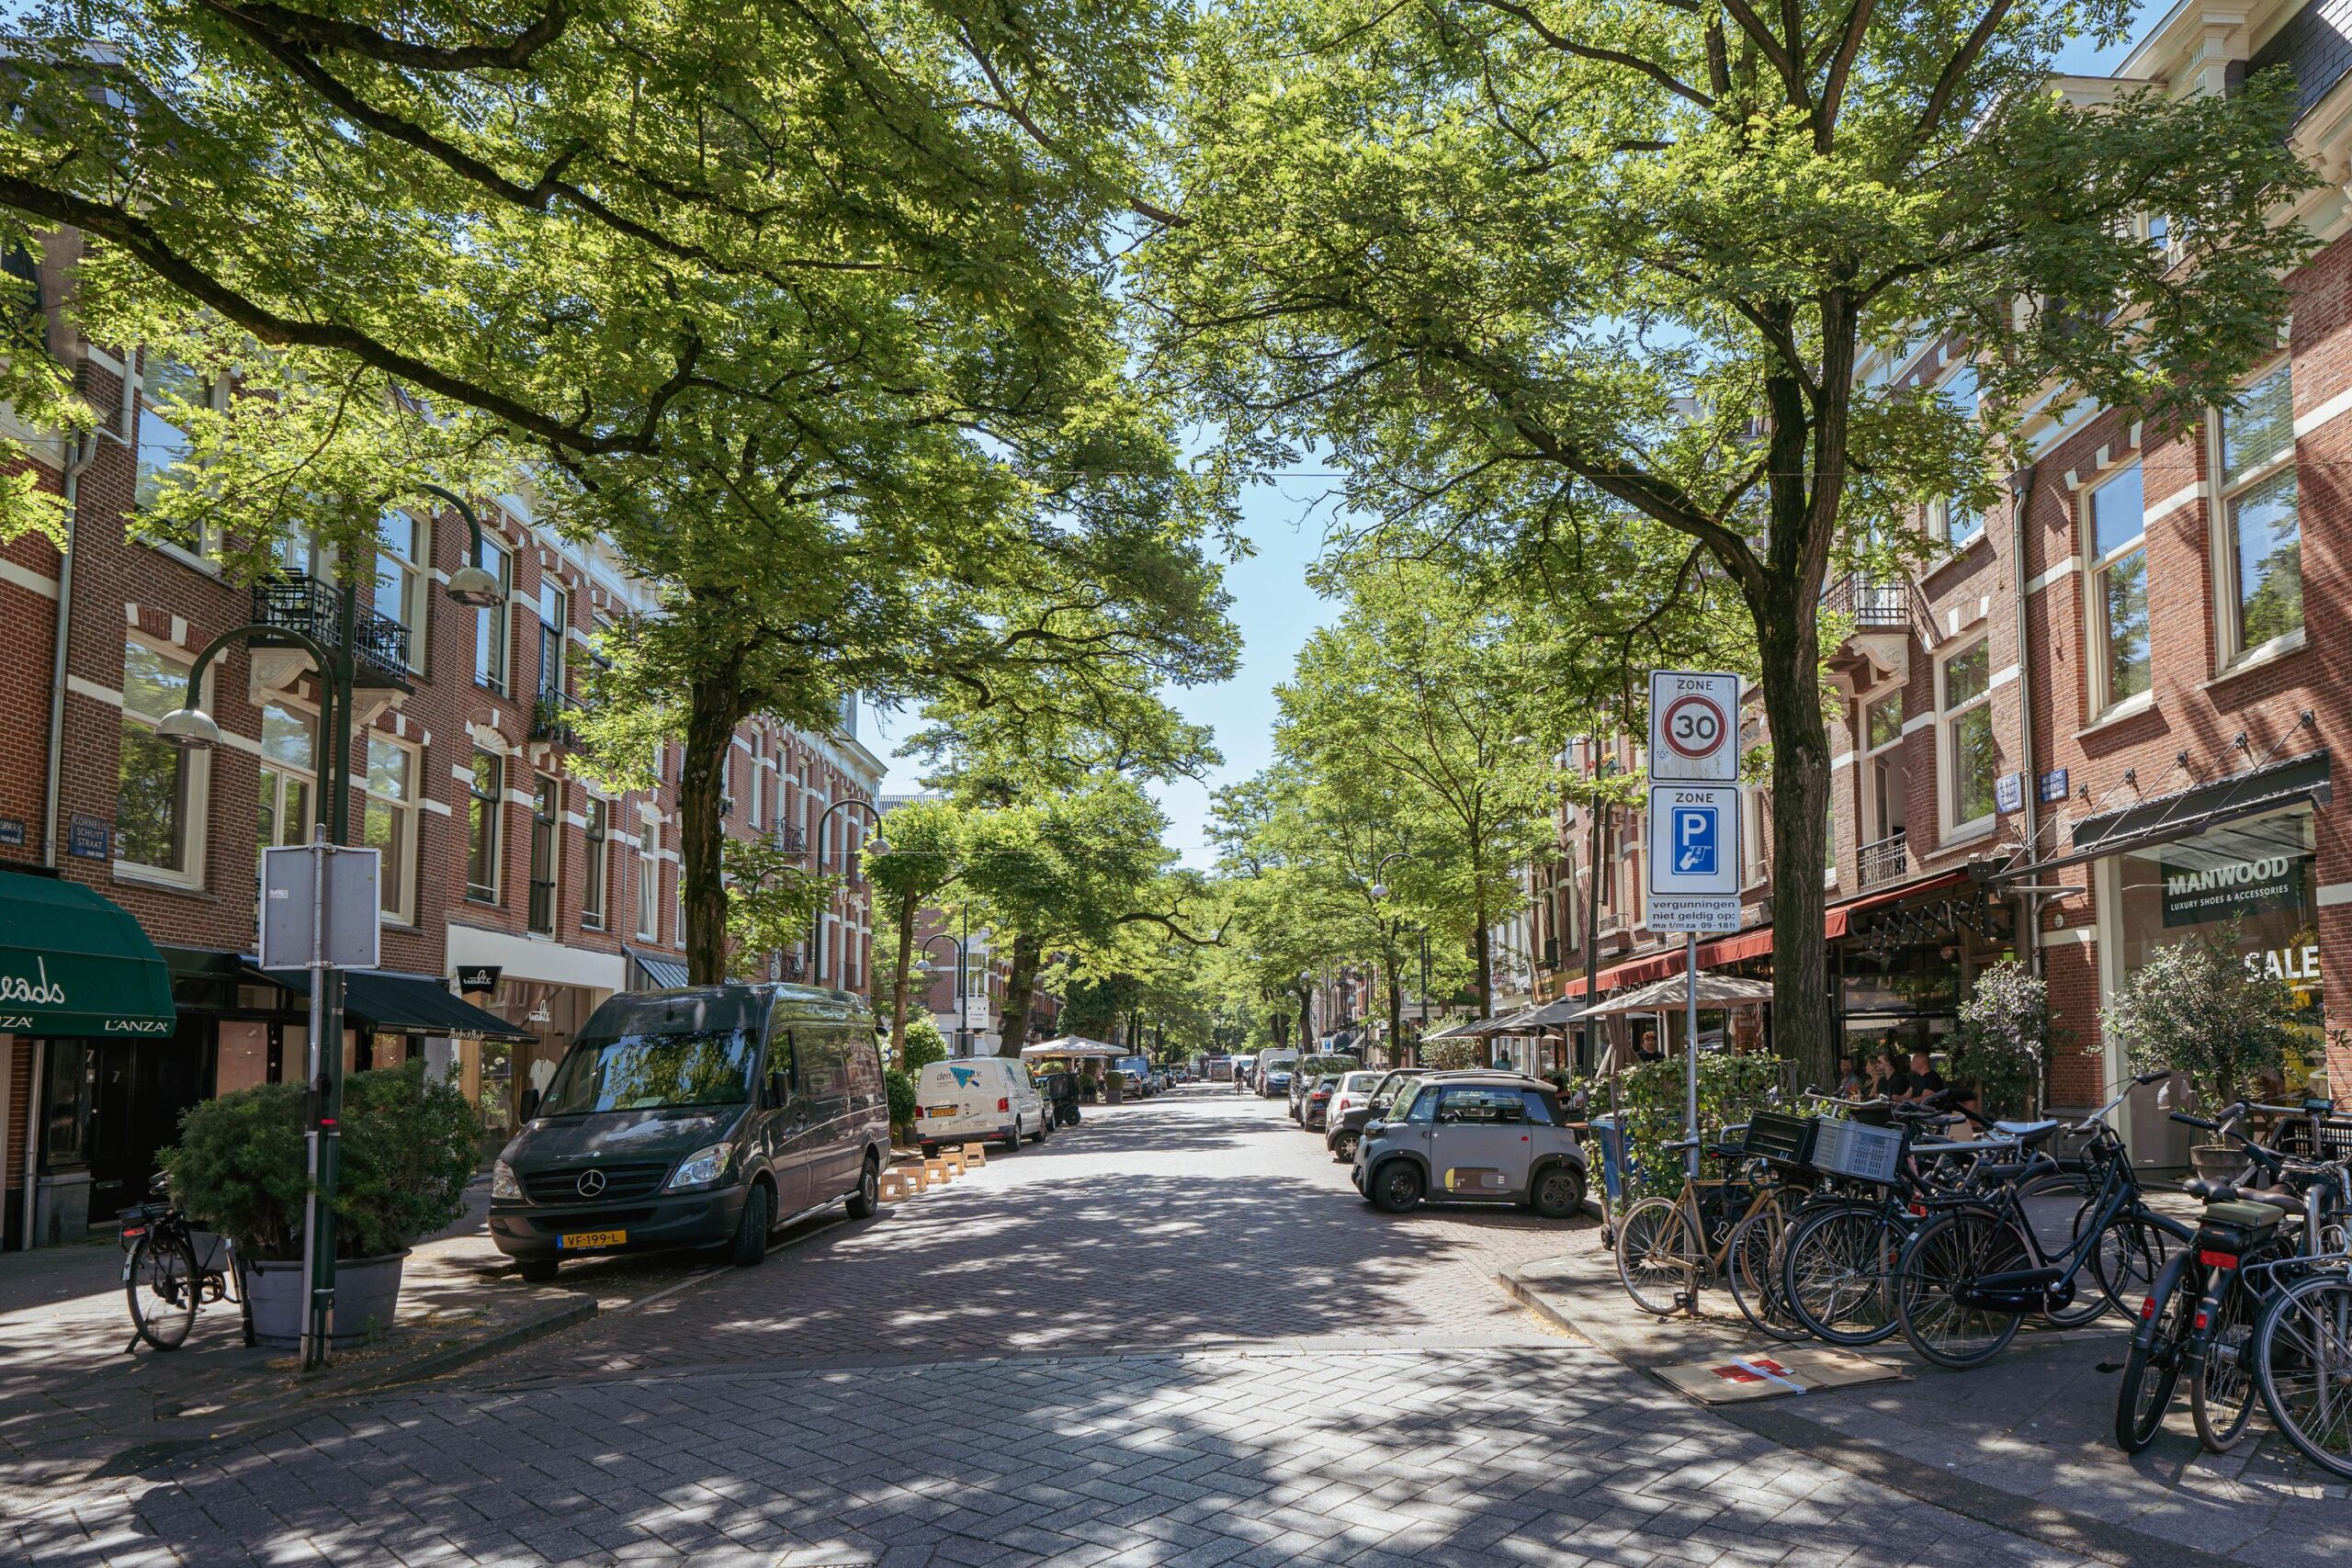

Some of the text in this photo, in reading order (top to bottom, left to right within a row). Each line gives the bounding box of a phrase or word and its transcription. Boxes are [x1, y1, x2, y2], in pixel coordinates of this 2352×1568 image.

[1677, 679, 1713, 691] ZONE
[1675, 715, 1716, 740] 30
[1675, 793, 1714, 804] ZONE
[74, 816, 108, 831] CORNELIS
[1682, 813, 1707, 846] P
[76, 828, 105, 840] SCHUYT
[77, 838, 103, 850] STRAAT
[2167, 856, 2290, 897] MANWOOD
[2170, 885, 2289, 911] LUXURY SHOES & ACCESSORIES
[1653, 900, 1736, 909] vergunningen
[1653, 911, 1736, 921] niet geldig op:
[2244, 945, 2321, 983] SALE
[86, 1050, 95, 1062] 7
[112, 1070, 122, 1083] 7
[936, 1072, 951, 1081] den
[568, 1233, 619, 1246] VF-199-L
